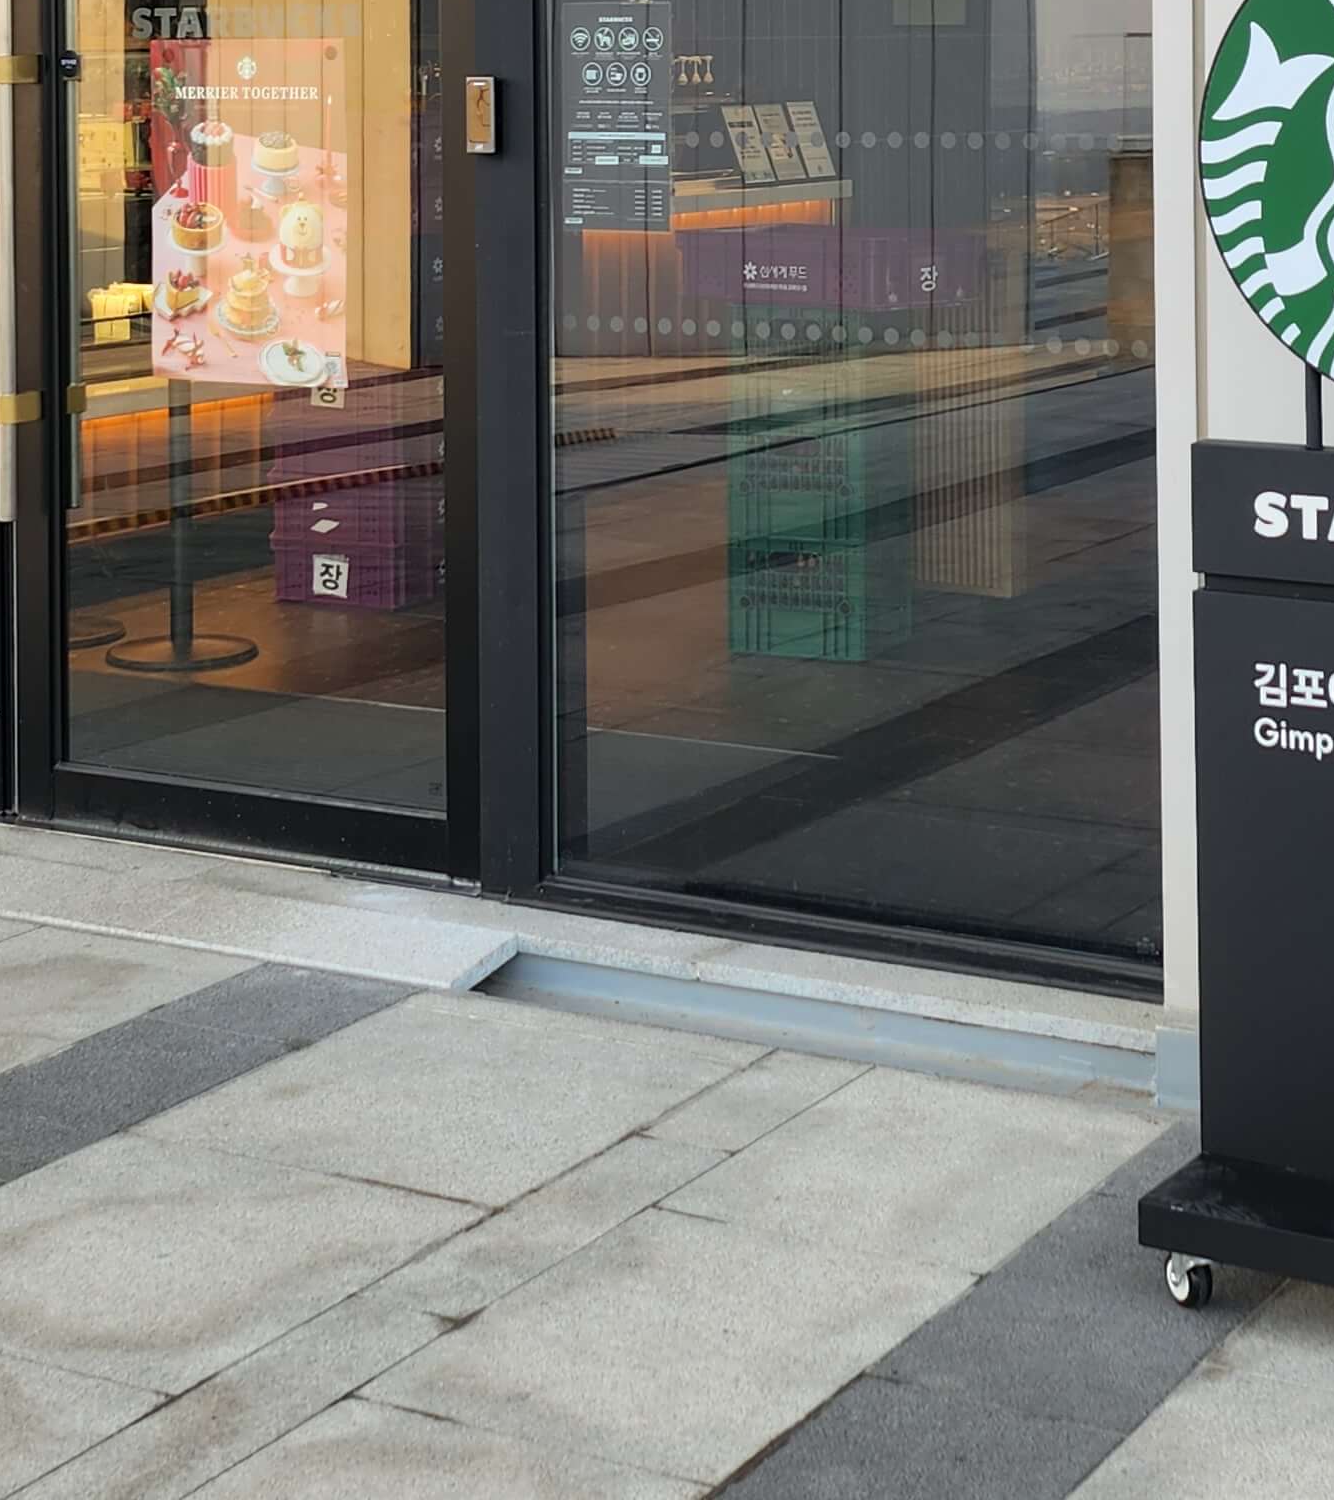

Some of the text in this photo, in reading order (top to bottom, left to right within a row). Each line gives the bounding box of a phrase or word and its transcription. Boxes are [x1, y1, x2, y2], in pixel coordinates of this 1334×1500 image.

[174, 86, 319, 100] MERRIER TOGETHER
[919, 265, 939, 291] 장
[320, 562, 342, 591] 장
